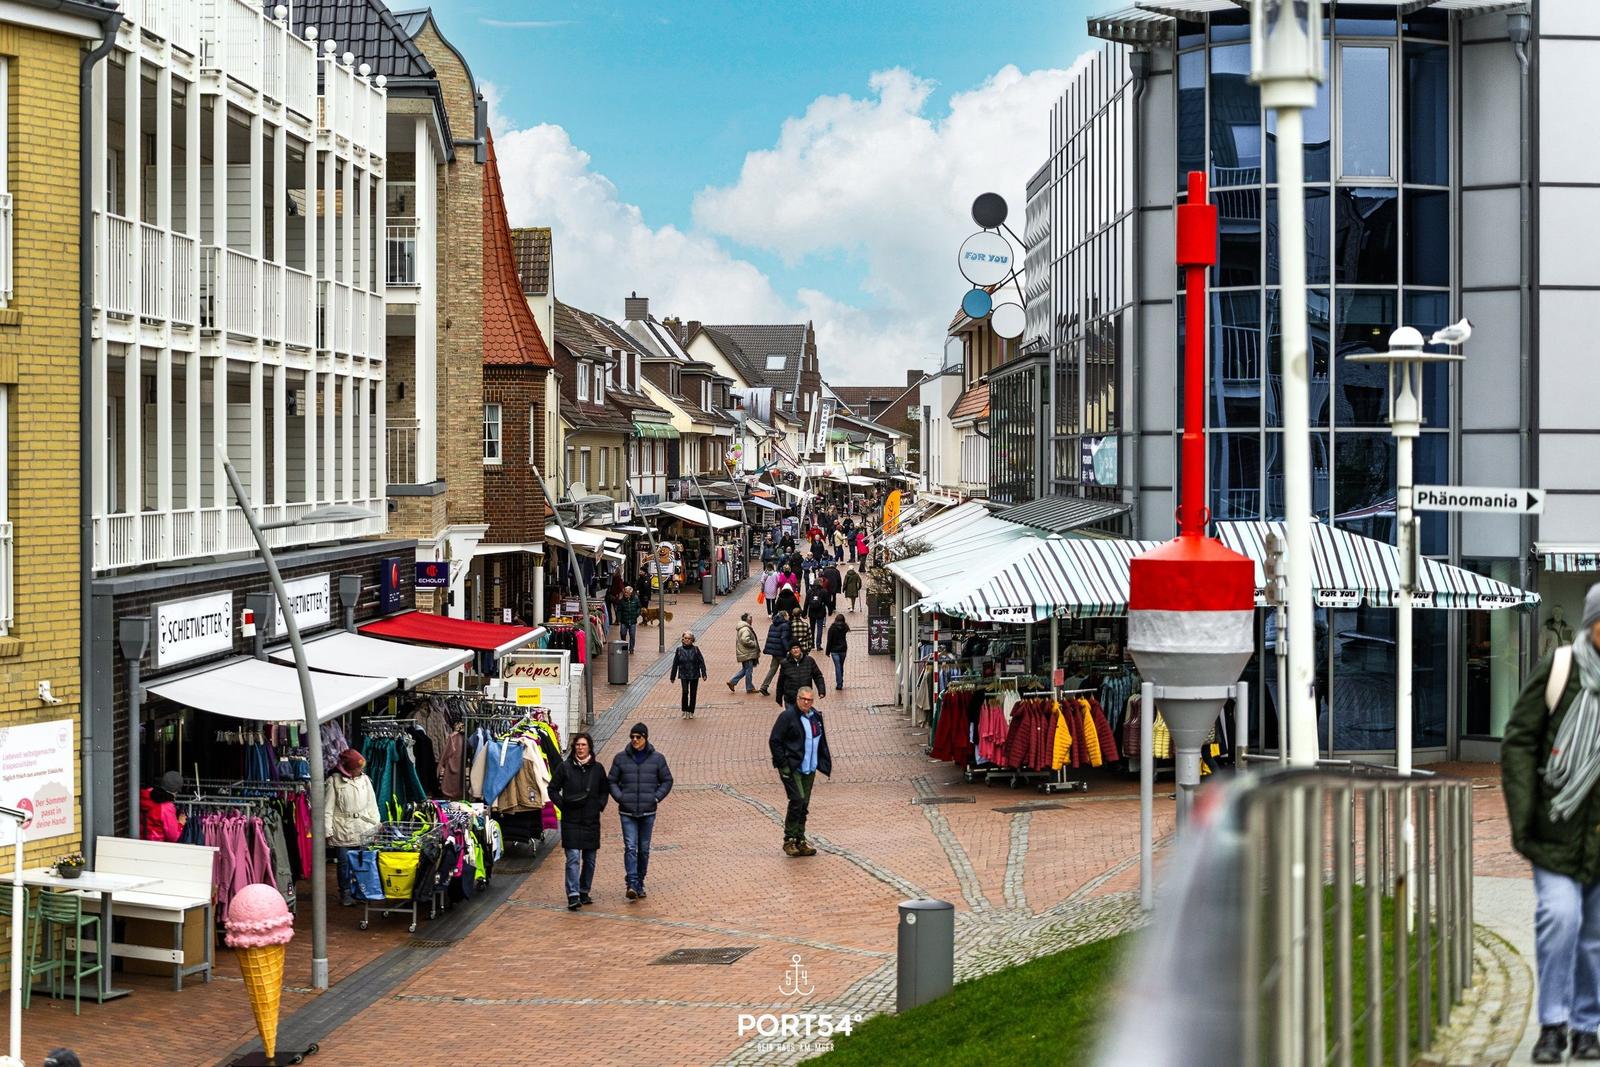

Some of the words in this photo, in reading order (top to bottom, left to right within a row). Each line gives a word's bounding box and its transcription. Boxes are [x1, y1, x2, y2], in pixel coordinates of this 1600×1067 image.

[965, 252, 986, 261] FOR
[988, 255, 1008, 263] YOU
[1418, 491, 1518, 508] Phänomania
[1012, 607, 1028, 615] YOU
[168, 612, 223, 643] SCHIETWETTER
[503, 661, 559, 681] Crêpes
[36, 799, 45, 807] Der
[46, 796, 67, 805] Sommer
[41, 809, 55, 818] passt
[36, 820, 51, 829] deine
